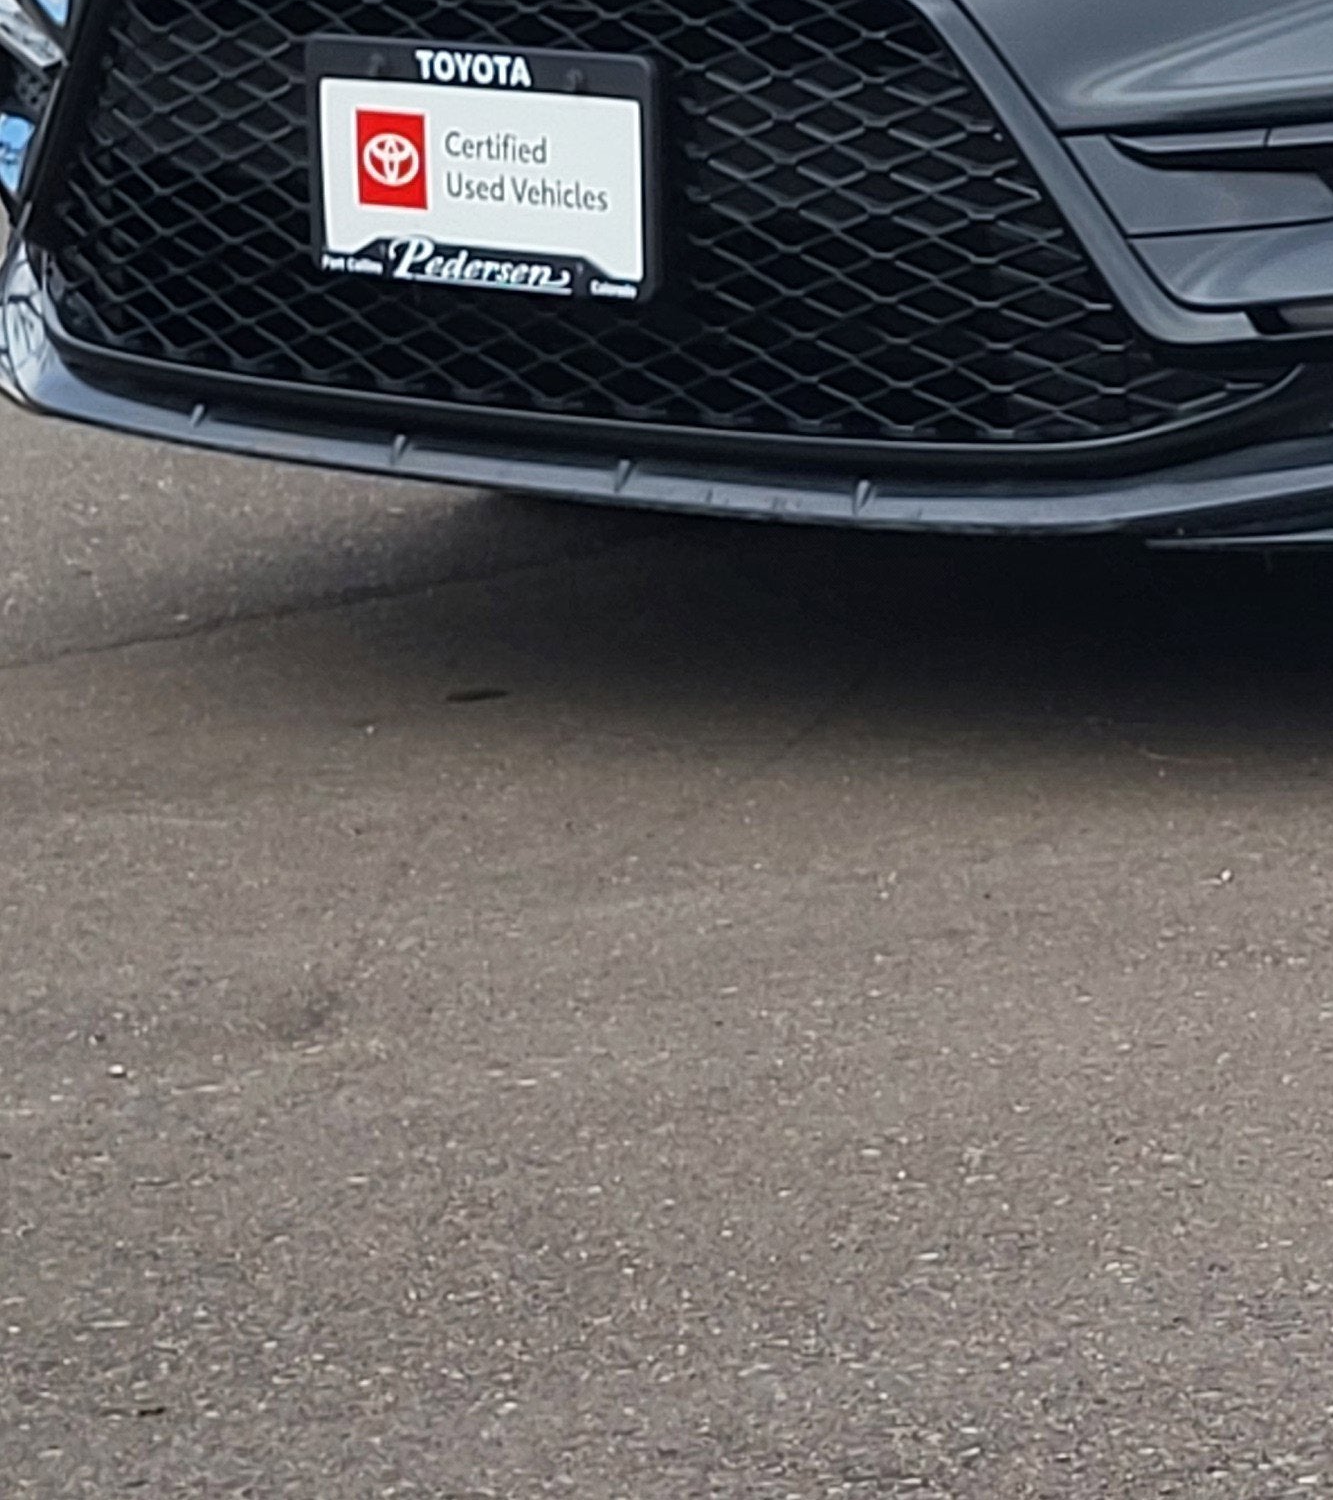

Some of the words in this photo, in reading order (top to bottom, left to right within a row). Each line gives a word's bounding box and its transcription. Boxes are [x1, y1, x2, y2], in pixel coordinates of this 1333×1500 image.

[415, 50, 532, 87] TOYOTA
[444, 131, 547, 164] Certified
[447, 172, 505, 201] Used
[511, 177, 609, 211] Vehicles
[388, 238, 572, 294] Pedersen
